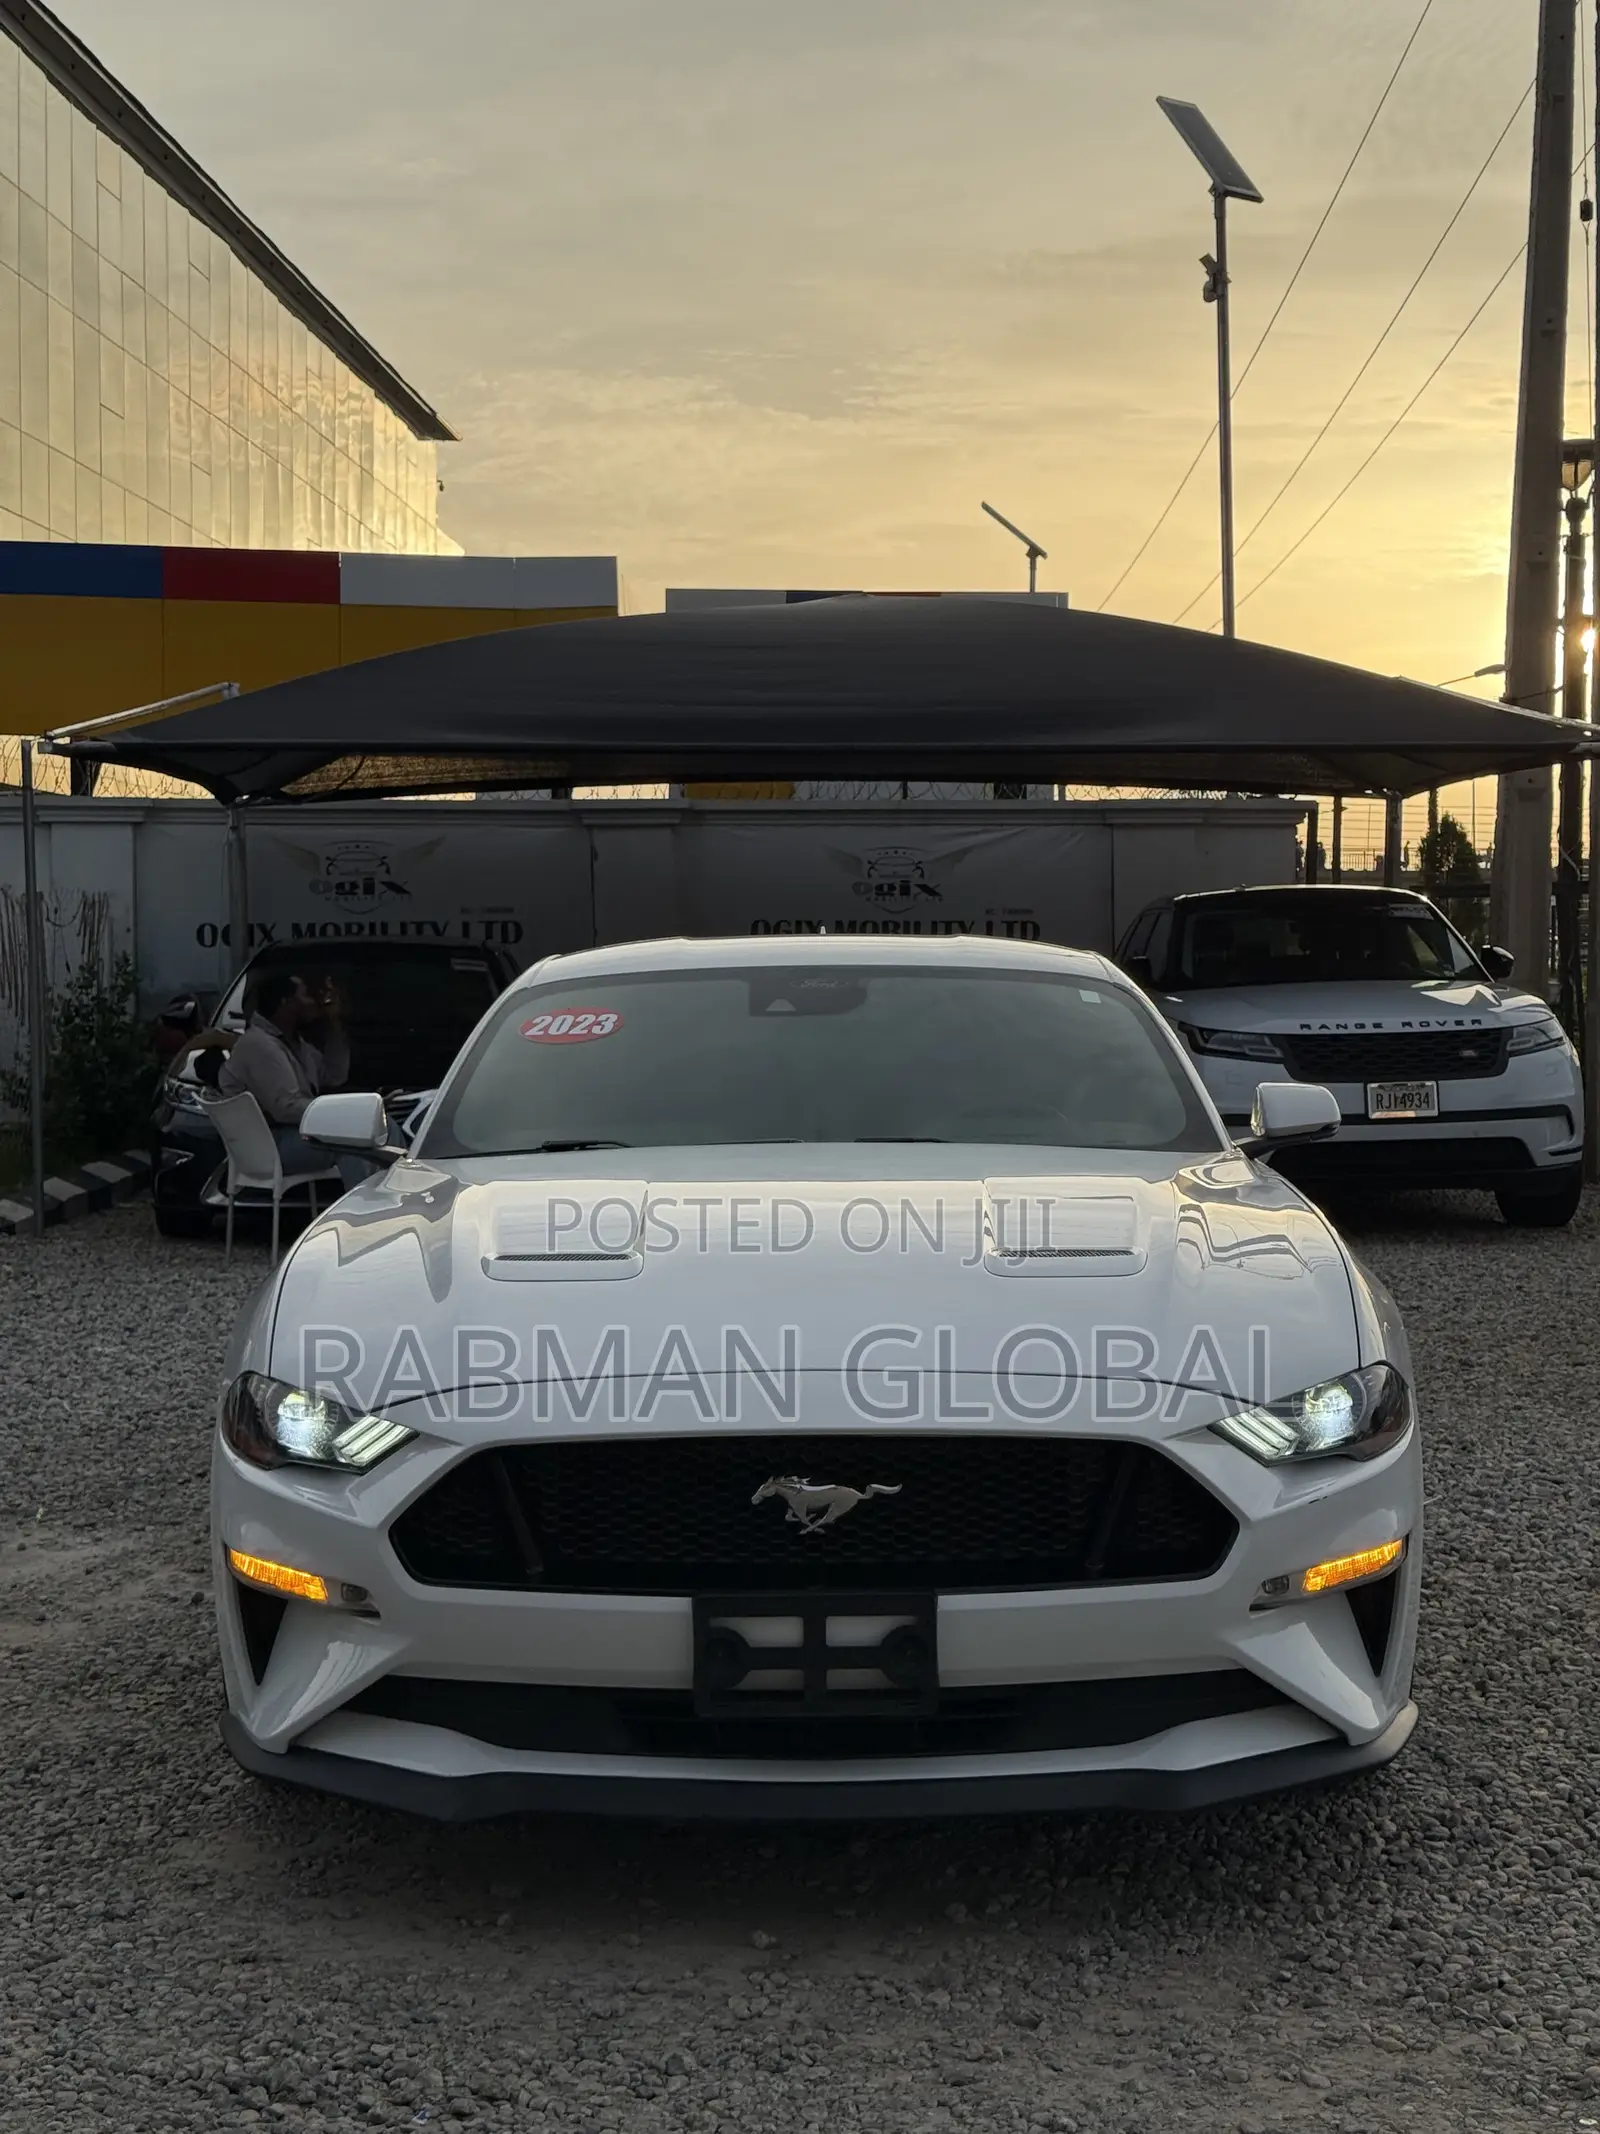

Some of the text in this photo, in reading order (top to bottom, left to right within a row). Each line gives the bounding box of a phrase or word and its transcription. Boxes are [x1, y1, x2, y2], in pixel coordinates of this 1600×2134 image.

[525, 1013, 618, 1036] 2023
[1299, 1018, 1482, 1031] RANGE ROVER
